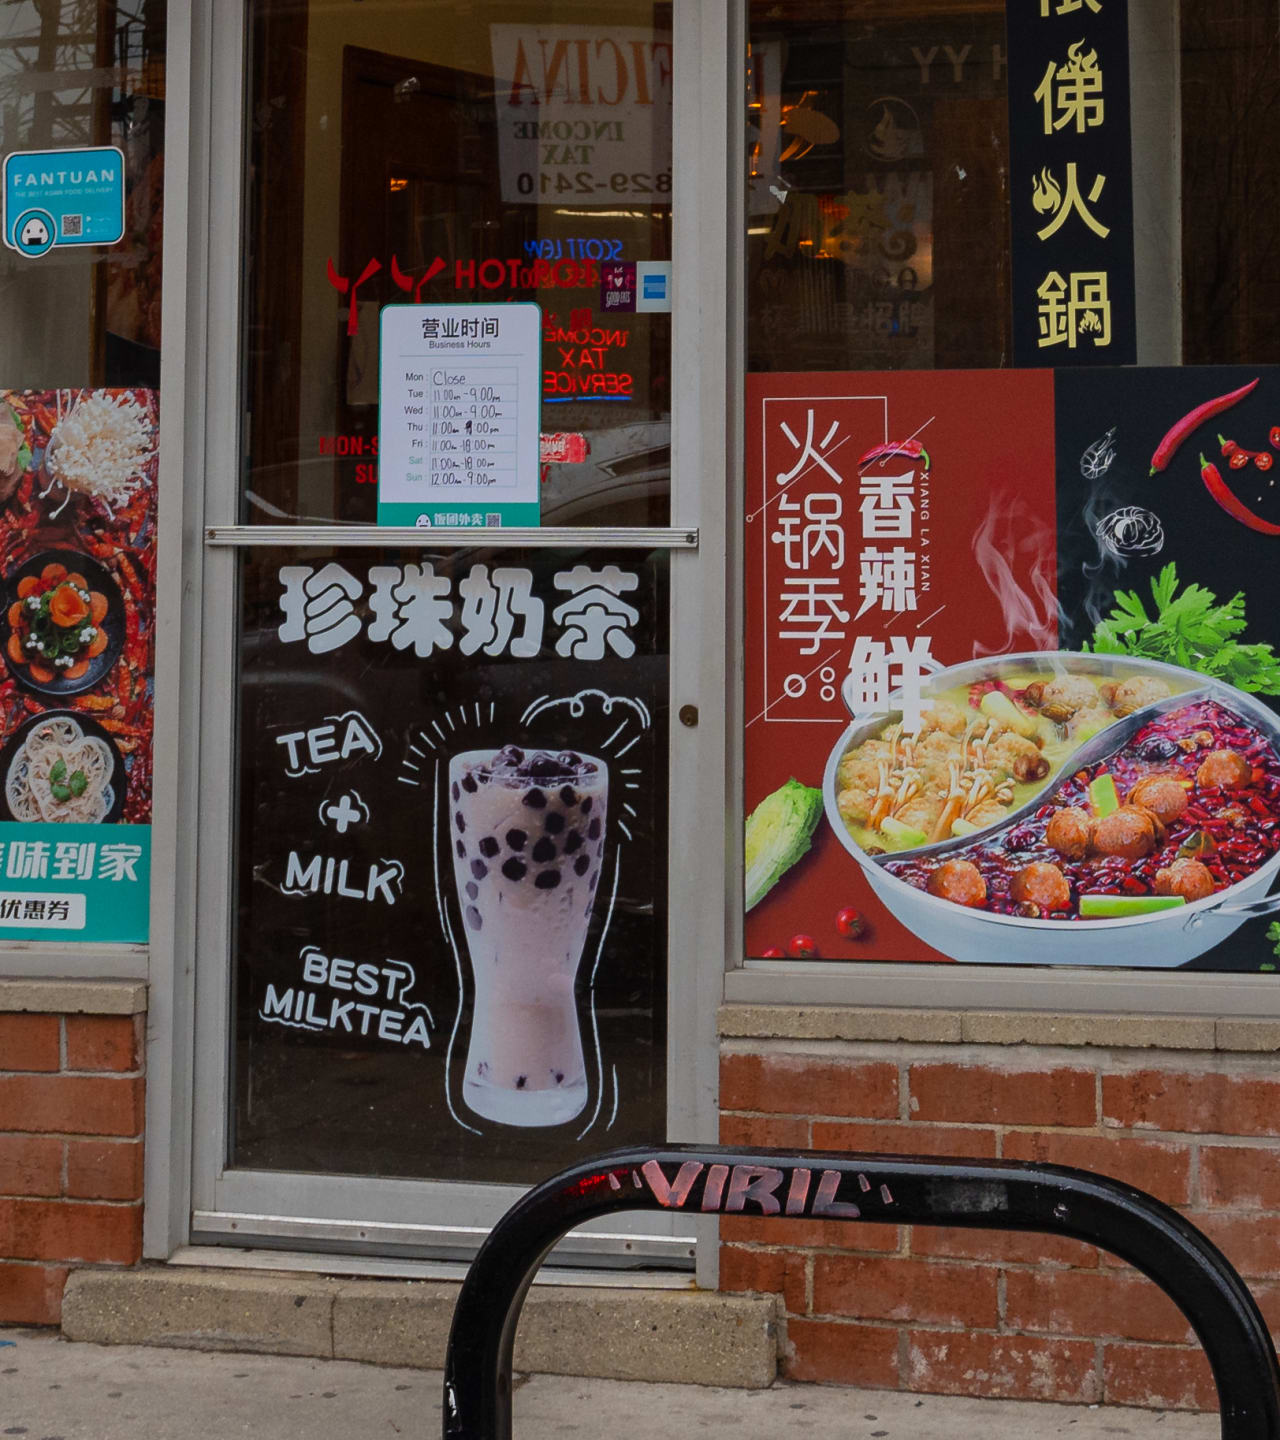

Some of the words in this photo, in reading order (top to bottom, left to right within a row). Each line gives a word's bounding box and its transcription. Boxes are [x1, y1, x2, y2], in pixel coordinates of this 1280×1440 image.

[13, 169, 115, 187] FANTUAN
[455, 259, 523, 290] HOT
[422, 317, 499, 339] 营业时间
[429, 340, 465, 349] Business
[467, 340, 491, 349] Hours
[405, 372, 424, 381] Mon
[433, 370, 466, 386] Close
[408, 389, 424, 398] Tue
[404, 406, 423, 415] Wed
[408, 422, 423, 431] Thu
[412, 439, 423, 448] Fri
[409, 456, 423, 465] Sat
[406, 473, 423, 481] Sun
[920, 472, 931, 521] XIANG
[773, 408, 850, 656] 火锅季
[920, 528, 931, 548] LA
[920, 554, 931, 592] XIAN
[278, 561, 640, 660] 珍珠奶茶
[276, 719, 376, 771] TEA
[285, 850, 397, 905] MILK
[302, 952, 408, 1002] BEST
[262, 984, 431, 1049] MILKTEA
[640, 1159, 860, 1218] VIRIL
